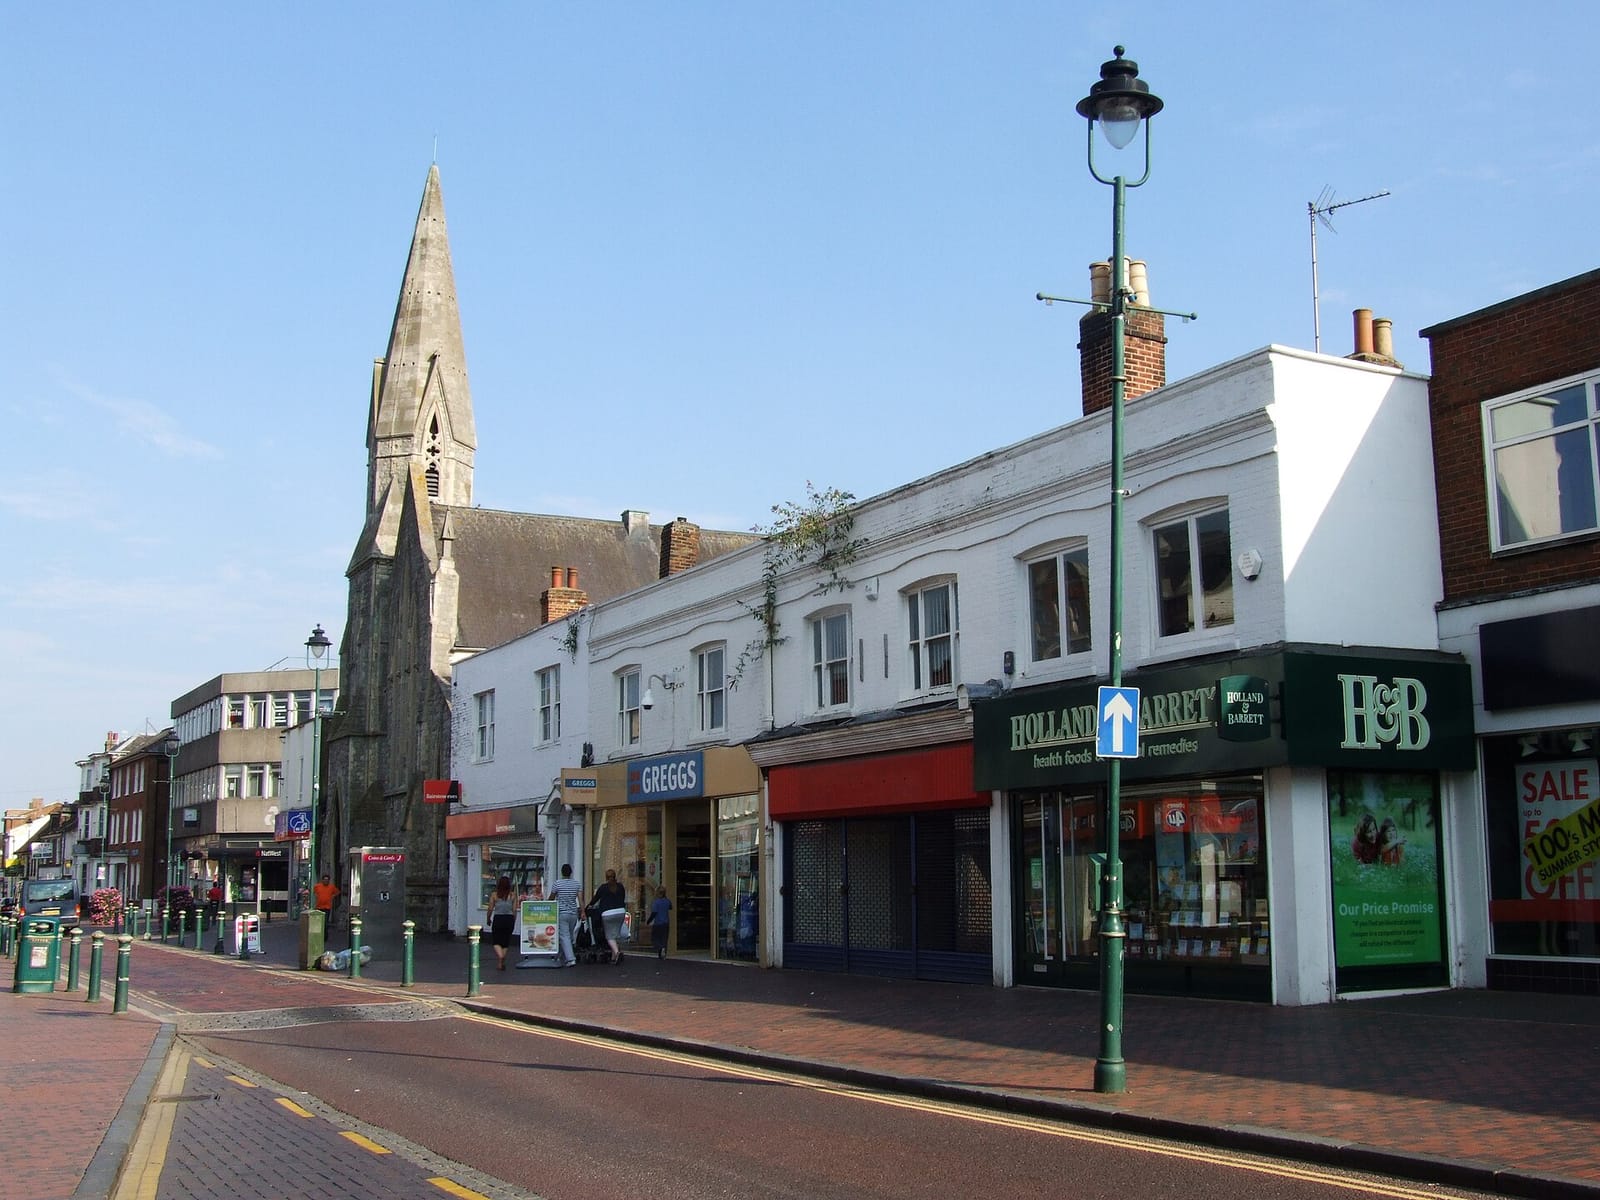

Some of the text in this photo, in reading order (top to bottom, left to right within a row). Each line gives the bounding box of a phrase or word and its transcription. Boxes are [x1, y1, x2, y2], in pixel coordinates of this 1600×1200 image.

[1227, 691, 1264, 704] HOLLAND
[1241, 702, 1250, 713] &
[1338, 674, 1430, 750] H&B
[1010, 686, 1216, 751] HOLLAND ARRET
[1228, 713, 1264, 725] BARRETT
[1033, 752, 1063, 768] health
[1065, 749, 1092, 765] foods
[1148, 738, 1198, 757] remedies
[642, 760, 697, 794] GREGGS
[1522, 769, 1589, 803] SALE
[1523, 808, 1542, 817] up to
[1527, 826, 1580, 867] 100's
[1539, 850, 1582, 881] SUMMER
[1339, 901, 1434, 916] Our Price Promise
